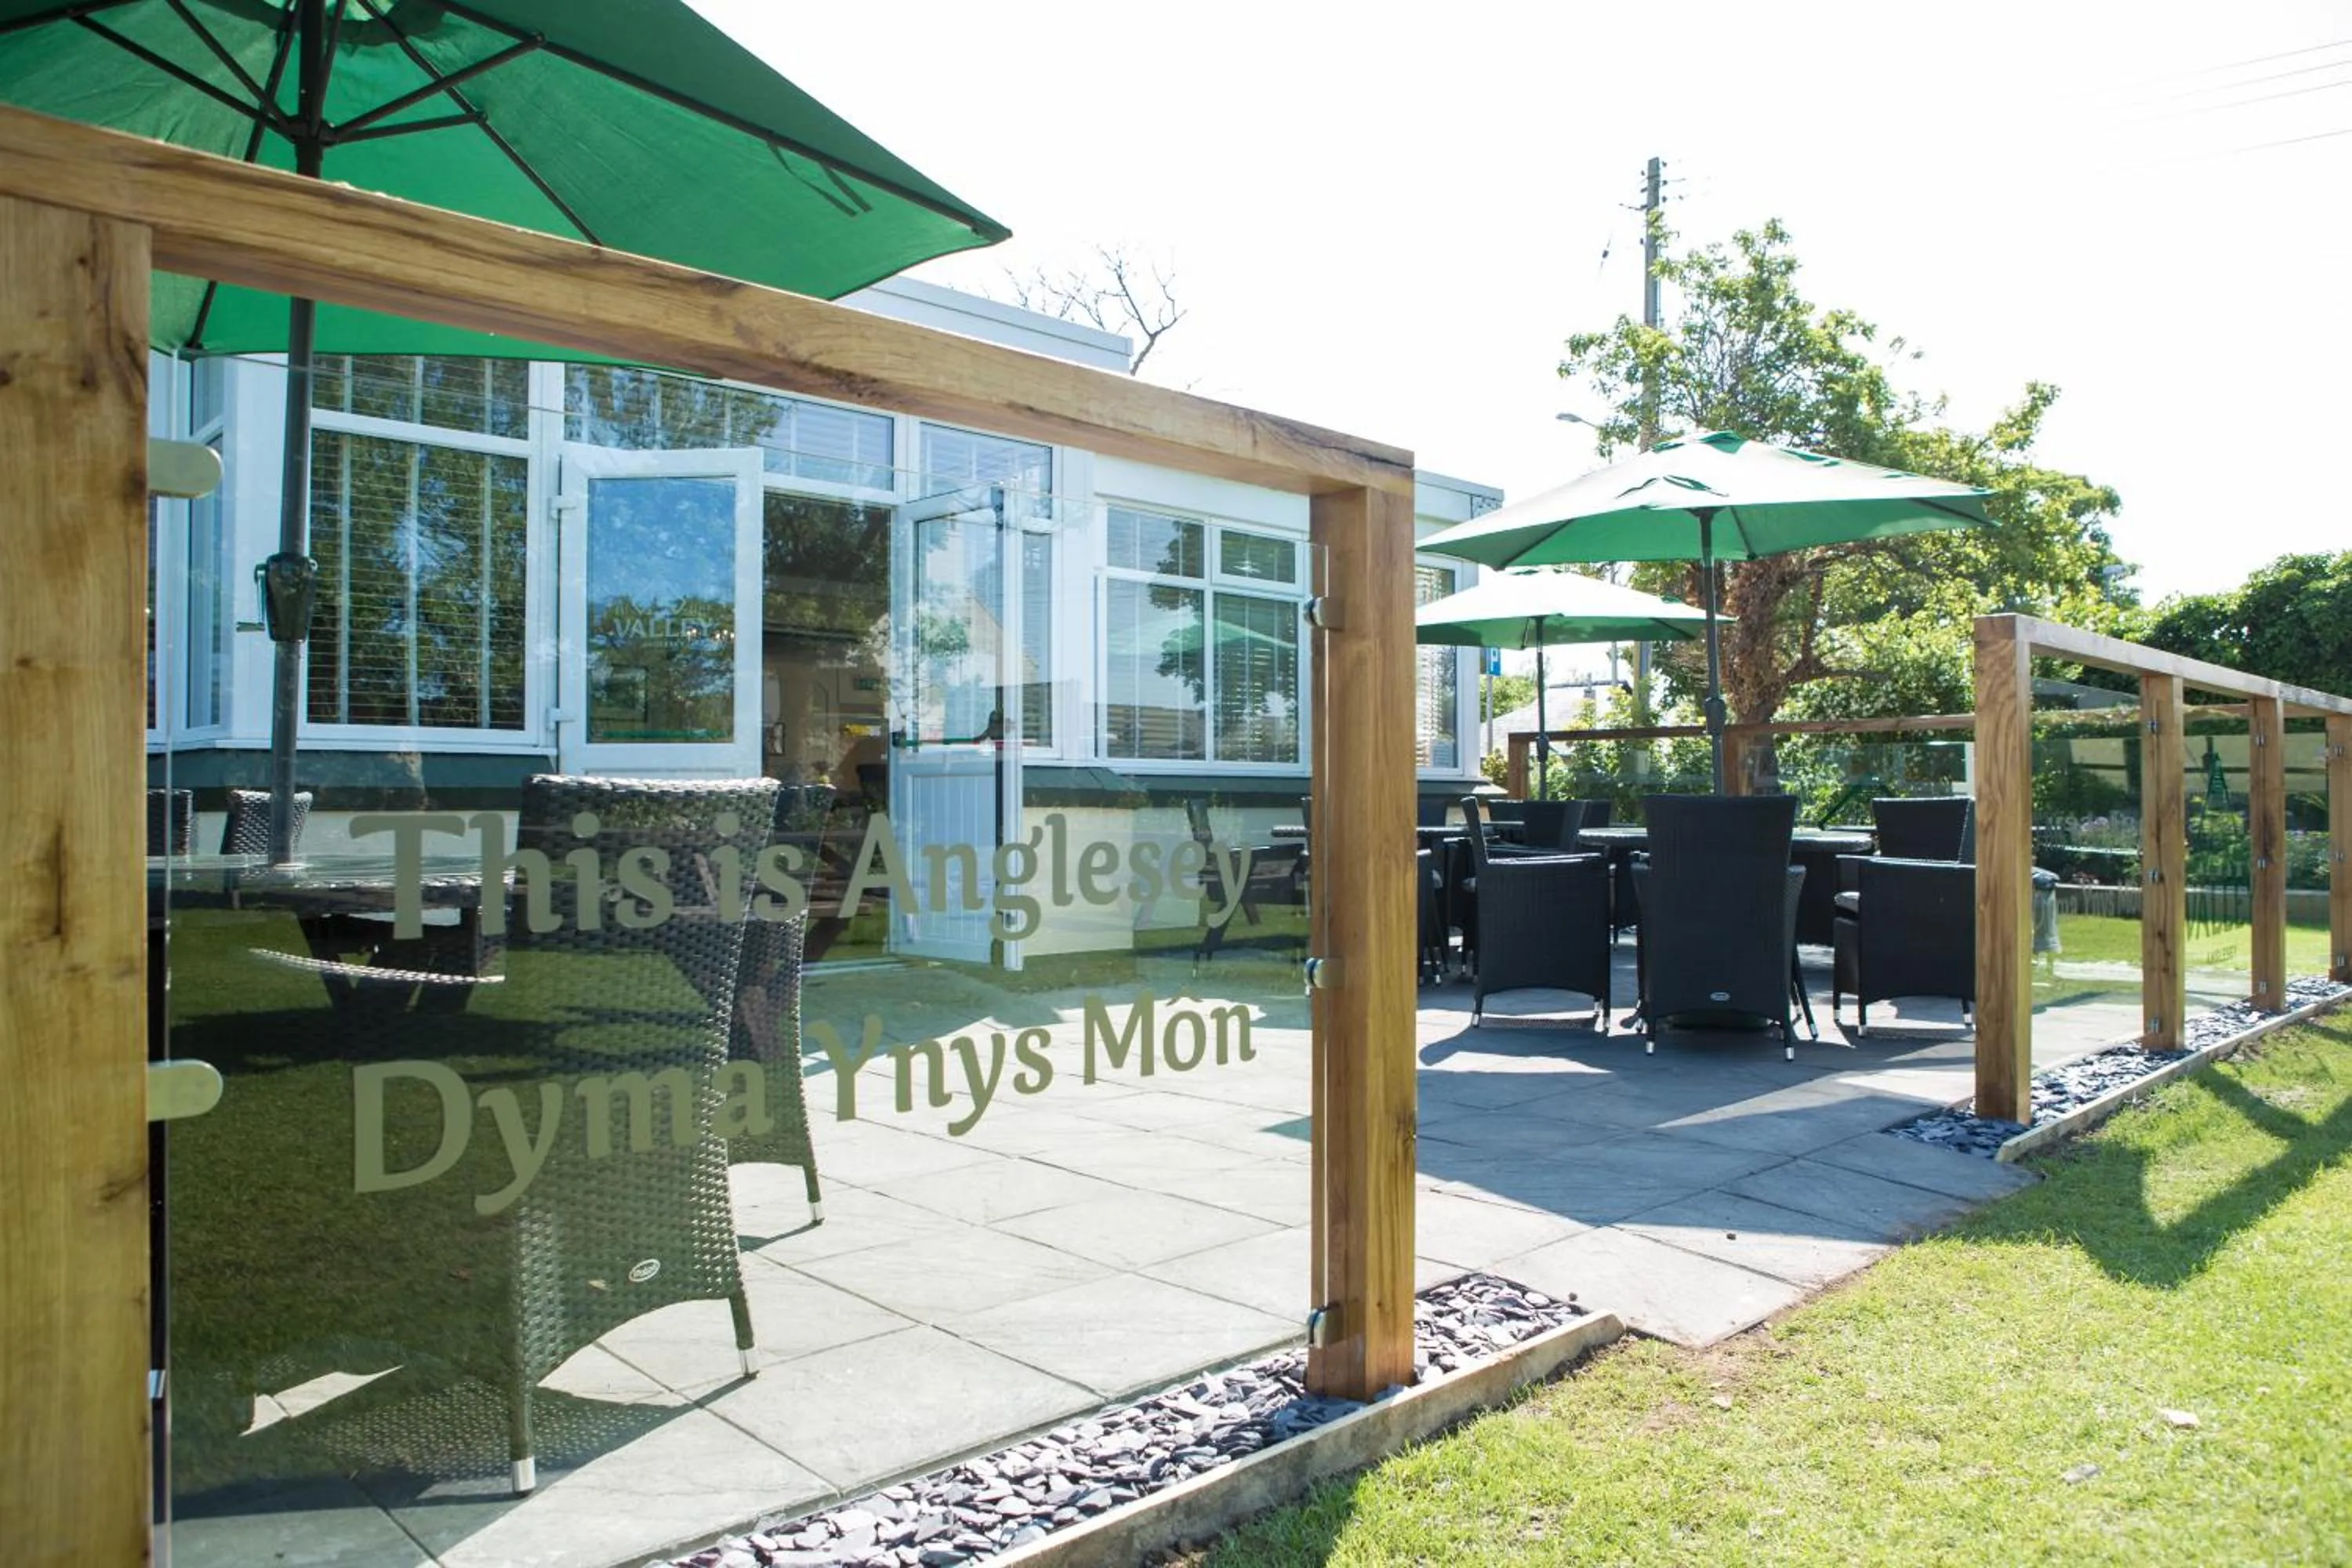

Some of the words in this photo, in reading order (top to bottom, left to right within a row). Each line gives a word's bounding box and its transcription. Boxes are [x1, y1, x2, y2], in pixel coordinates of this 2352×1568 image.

[614, 617, 719, 637] VALLEY
[349, 811, 673, 939] This
[706, 811, 806, 922] is
[838, 812, 1251, 940] Anglesey
[352, 1060, 775, 1215] Dyma
[804, 1014, 1052, 1137] Ynys
[1083, 986, 1256, 1086] Môn
